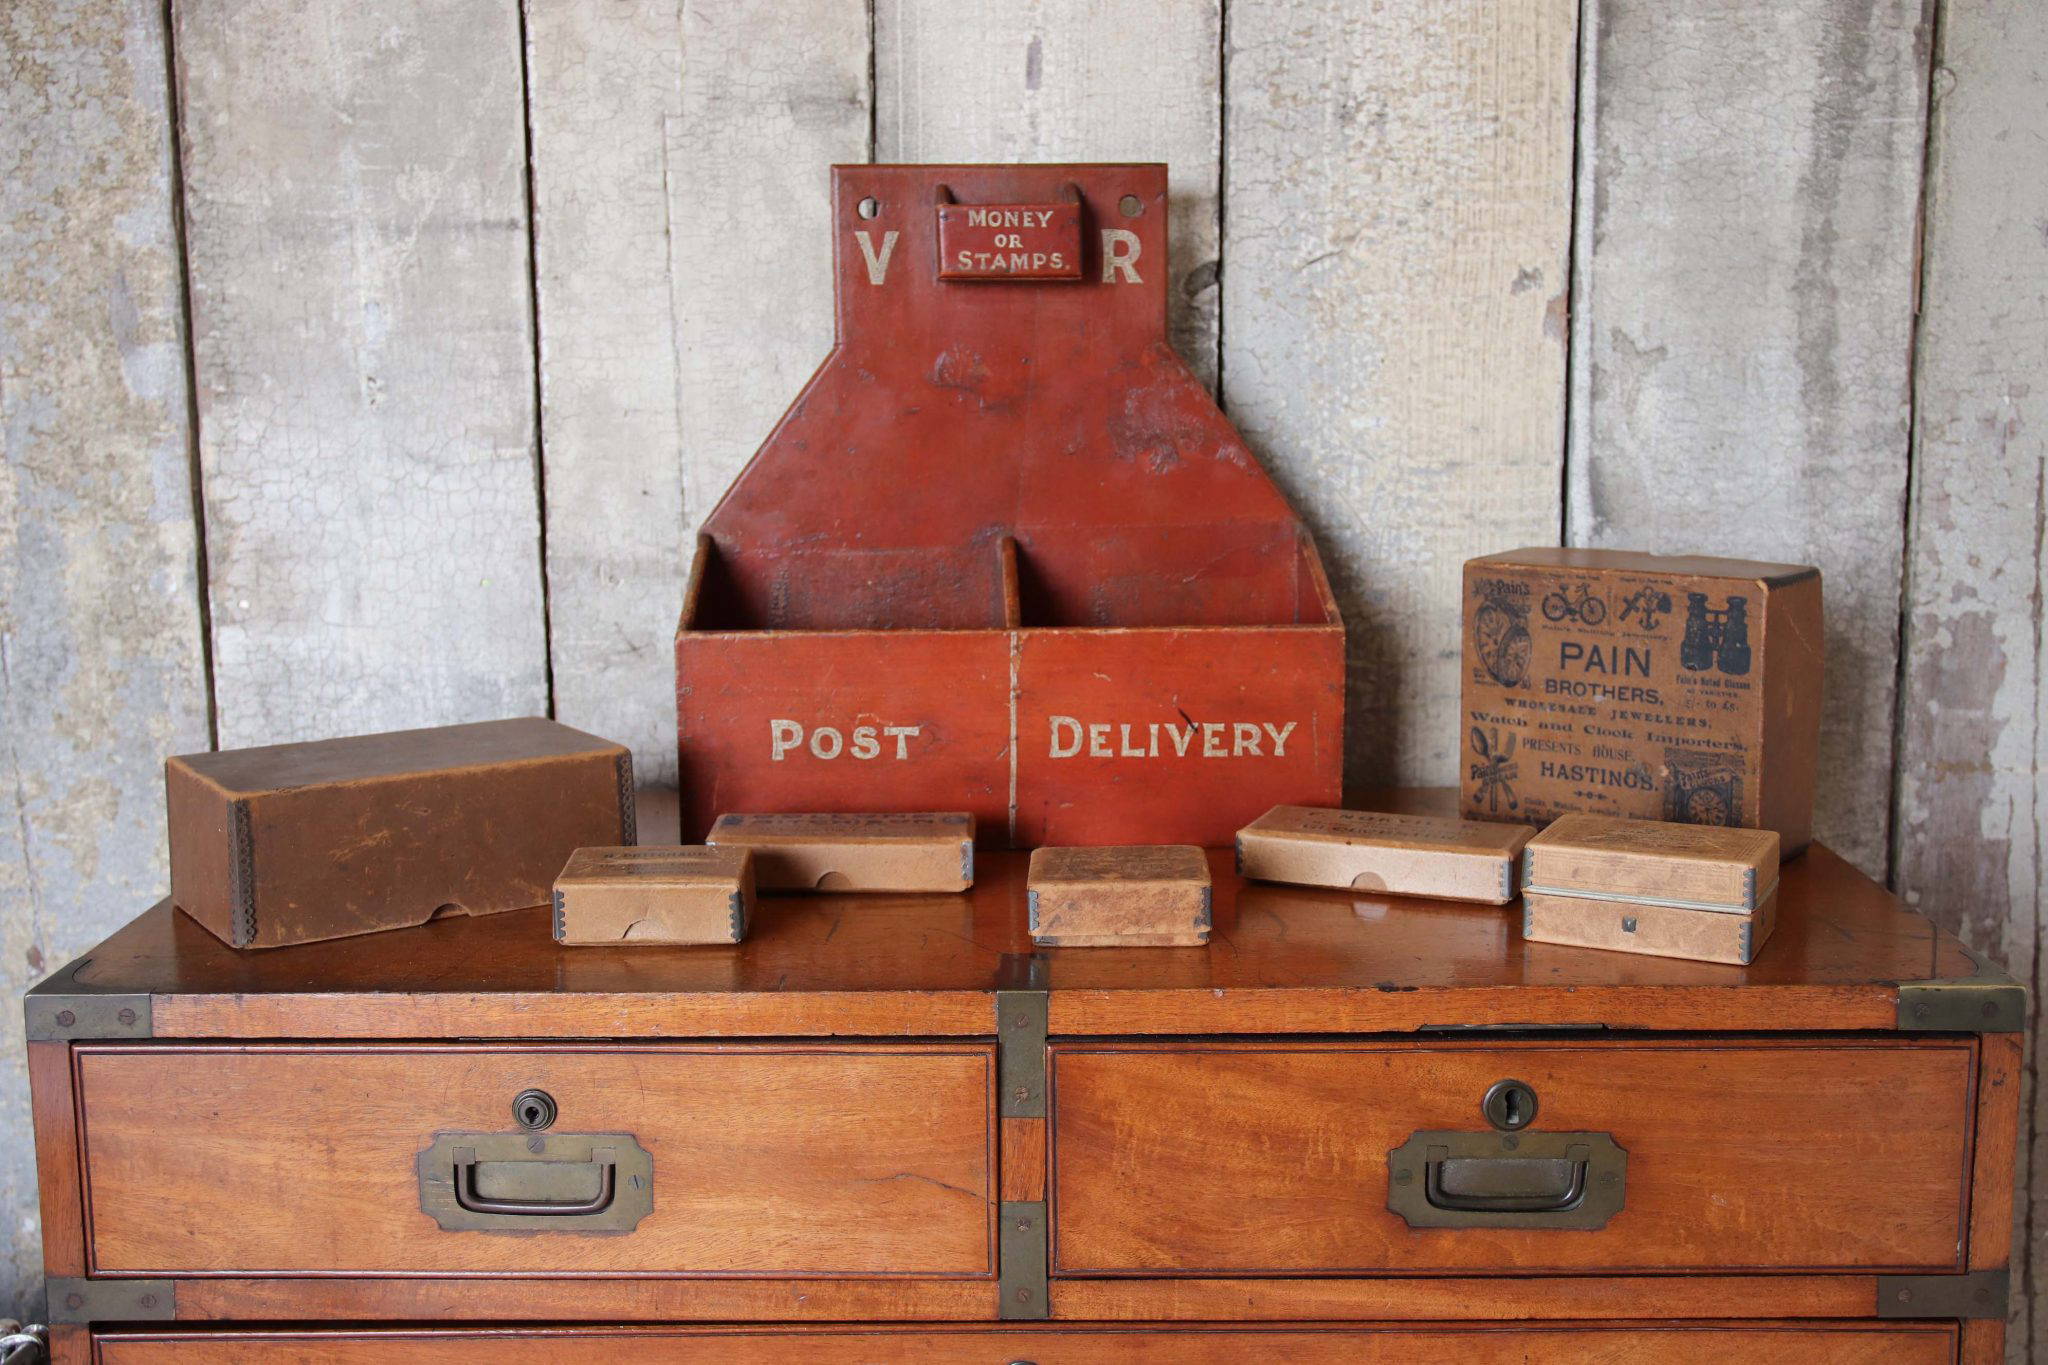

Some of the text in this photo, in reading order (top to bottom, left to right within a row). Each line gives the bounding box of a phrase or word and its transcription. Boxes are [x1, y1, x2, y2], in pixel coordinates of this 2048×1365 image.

[855, 231, 899, 285] V
[1101, 228, 1144, 284] R
[1560, 641, 1651, 677] PAIN
[1471, 711, 1528, 727] Watch
[1539, 721, 1573, 732] and
[1584, 725, 1633, 740] Clock
[1505, 698, 1597, 716] WHOLESALE
[769, 719, 920, 761] POST
[1049, 716, 1298, 758] DELIVERY
[1522, 738, 1582, 756] PRESENTS
